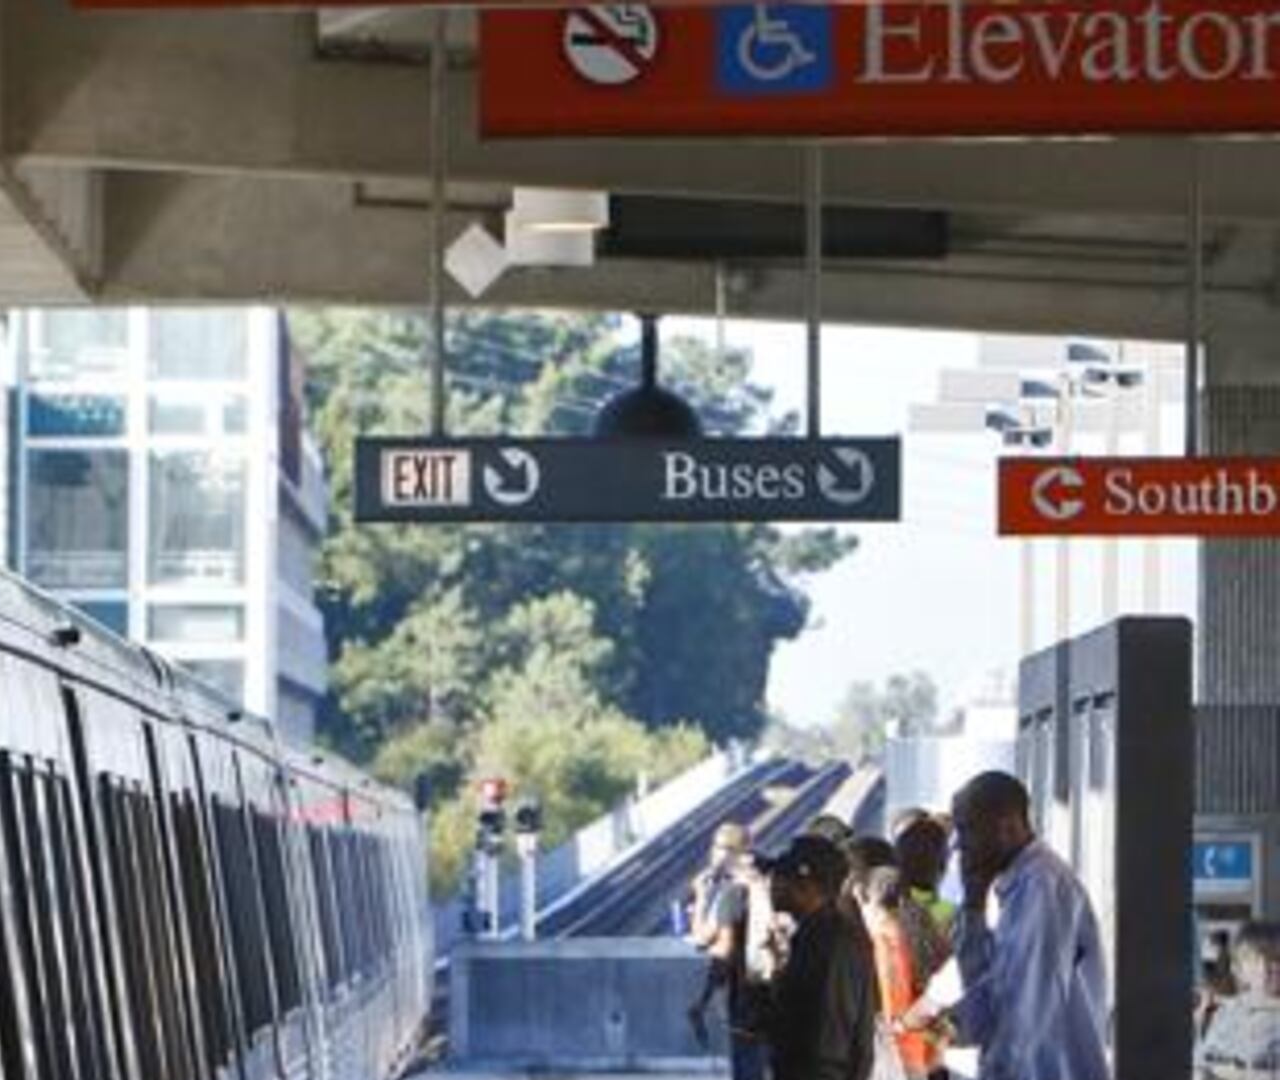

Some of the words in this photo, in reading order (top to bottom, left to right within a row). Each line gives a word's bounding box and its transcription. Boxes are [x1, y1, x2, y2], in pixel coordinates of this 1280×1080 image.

[392, 454, 457, 500] EXIT
[663, 451, 806, 500] Buses
[1103, 467, 1278, 516] Southb
